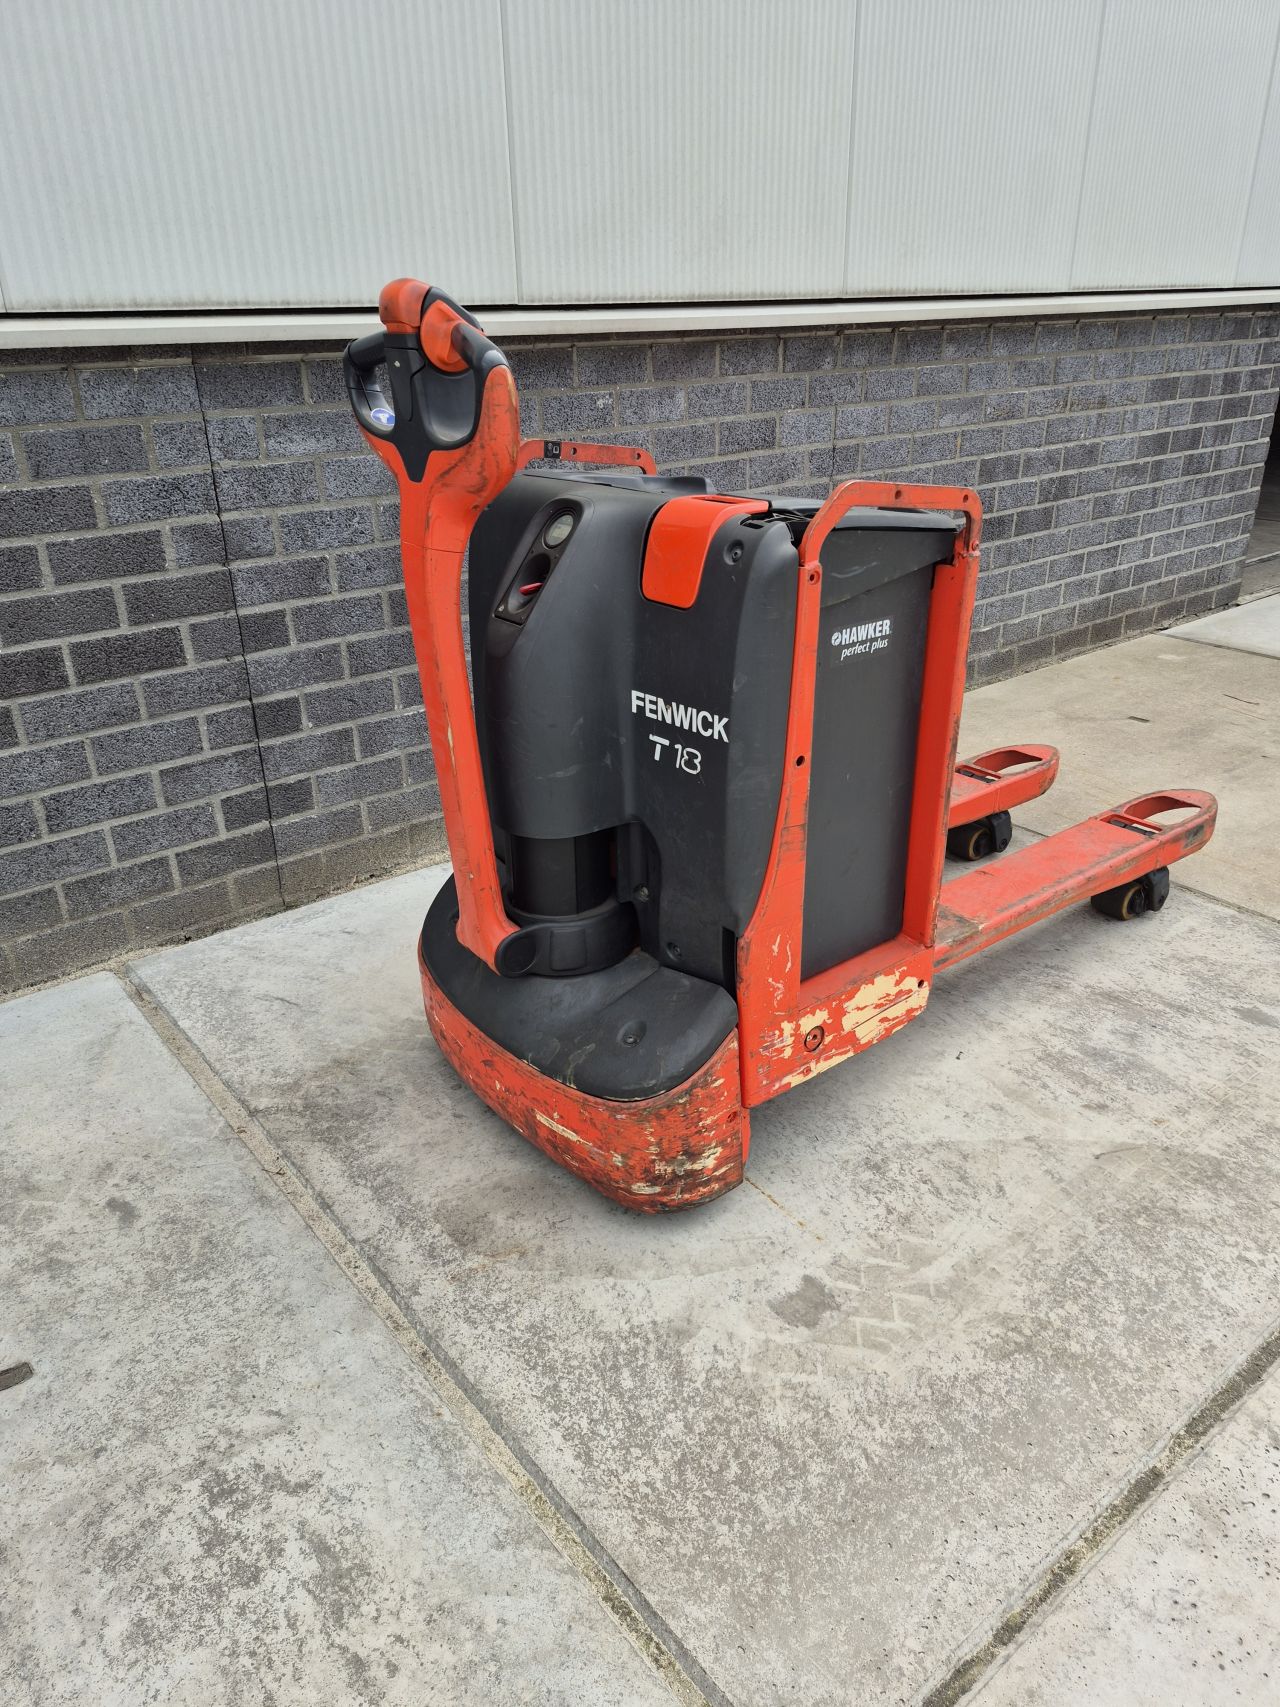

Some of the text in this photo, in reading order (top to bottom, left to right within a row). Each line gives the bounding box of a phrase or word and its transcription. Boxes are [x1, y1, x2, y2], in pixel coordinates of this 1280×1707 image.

[841, 619, 891, 646] HAWKER
[840, 637, 889, 661] perfect plus
[631, 689, 730, 743] FENWICK
